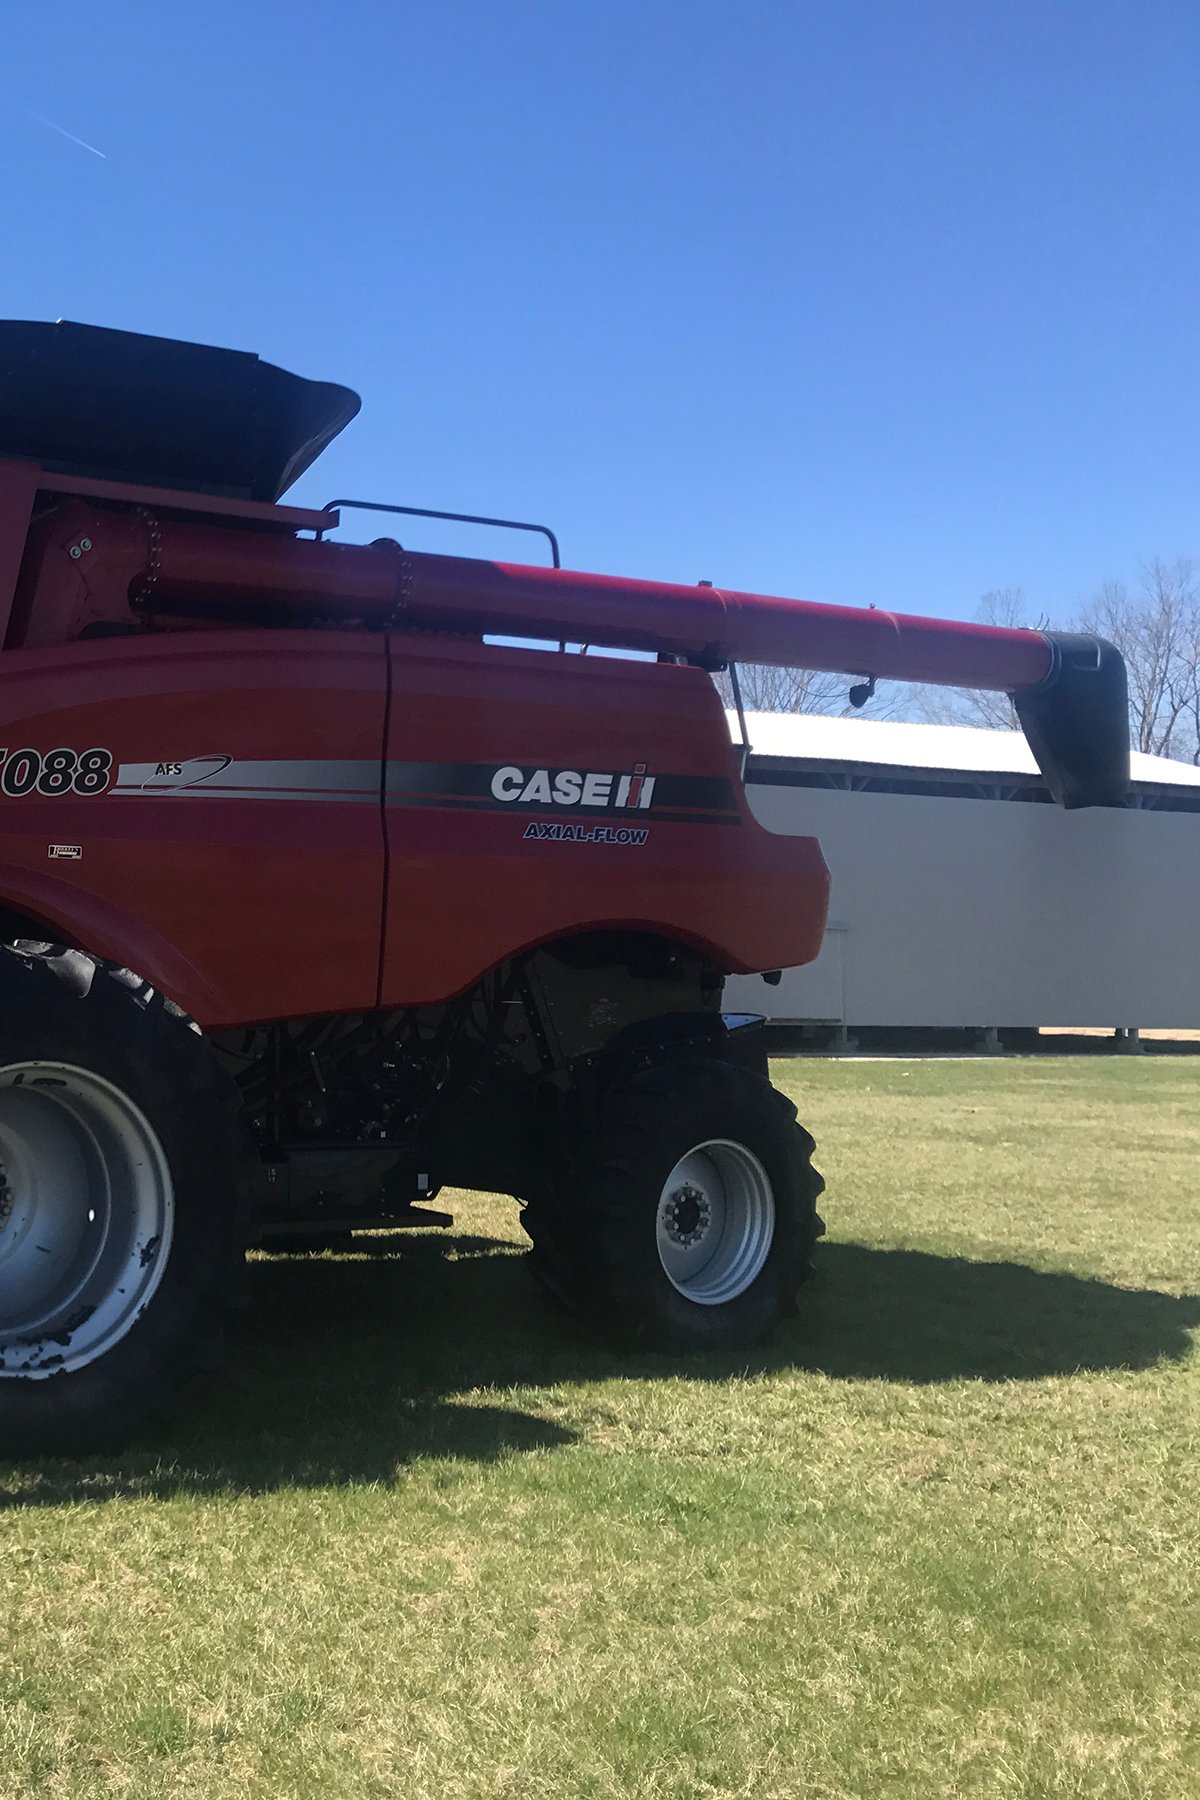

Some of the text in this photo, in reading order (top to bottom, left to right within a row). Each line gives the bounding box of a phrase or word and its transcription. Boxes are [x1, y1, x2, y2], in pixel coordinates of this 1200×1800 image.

[154, 762, 183, 776] AFS
[491, 766, 614, 807] CASE
[522, 822, 649, 846] AXIAL-FLOW
